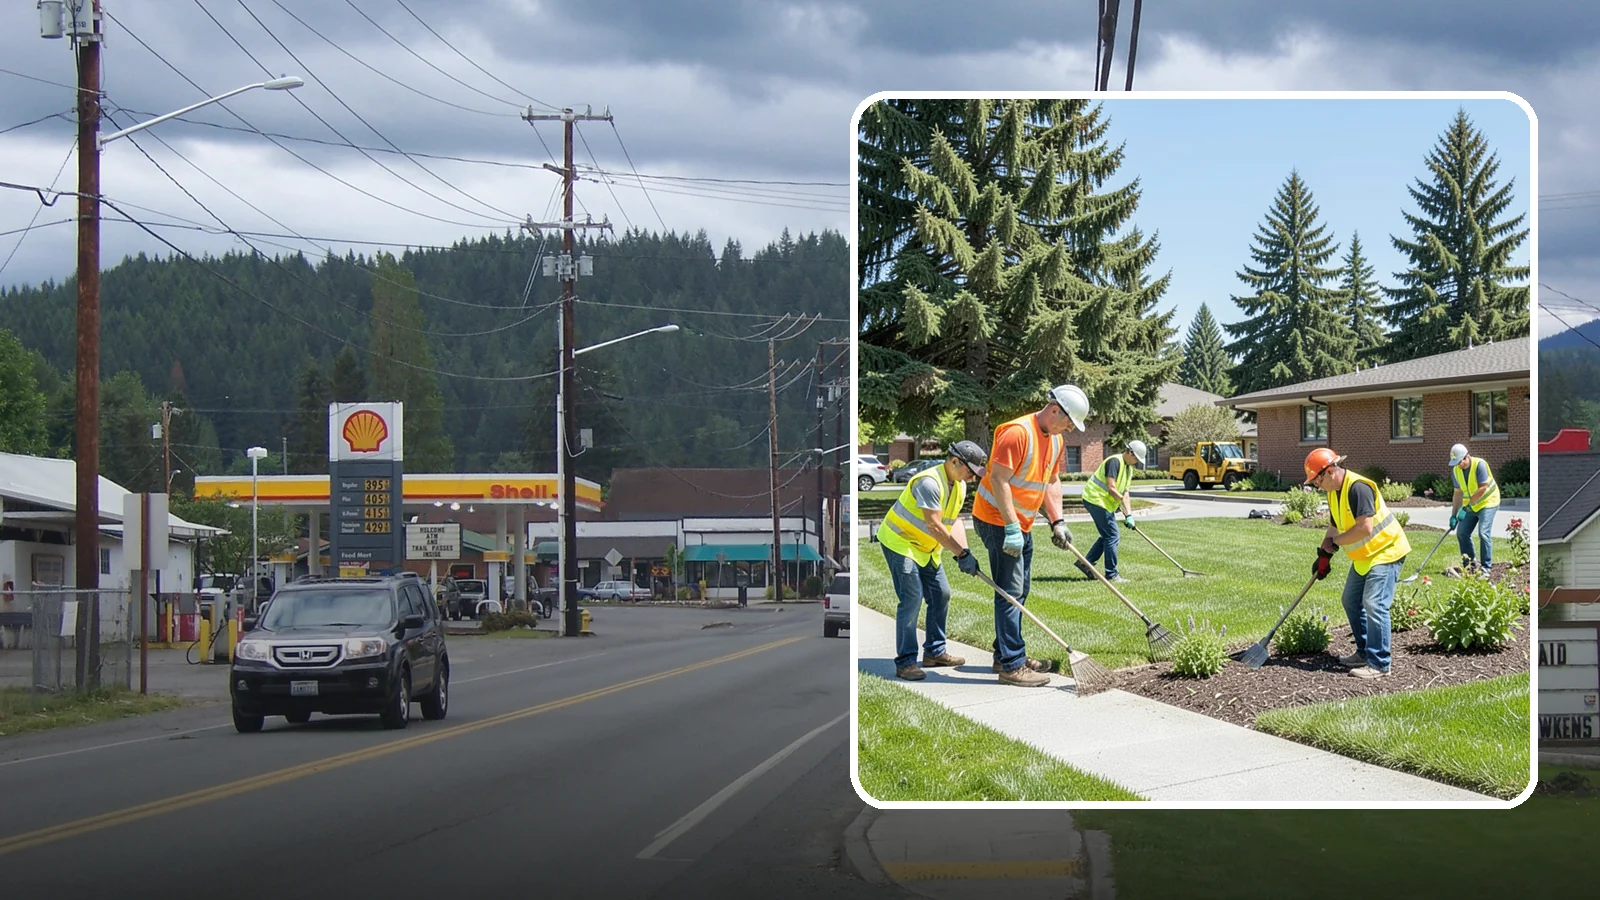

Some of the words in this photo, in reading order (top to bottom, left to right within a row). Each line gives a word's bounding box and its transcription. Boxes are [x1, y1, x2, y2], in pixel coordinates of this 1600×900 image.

[366, 480, 383, 490] 395
[490, 485, 547, 499] Shell
[366, 494, 383, 504] 405
[366, 508, 383, 518] 415
[366, 522, 383, 532] 429
[1538, 643, 1567, 666] AID
